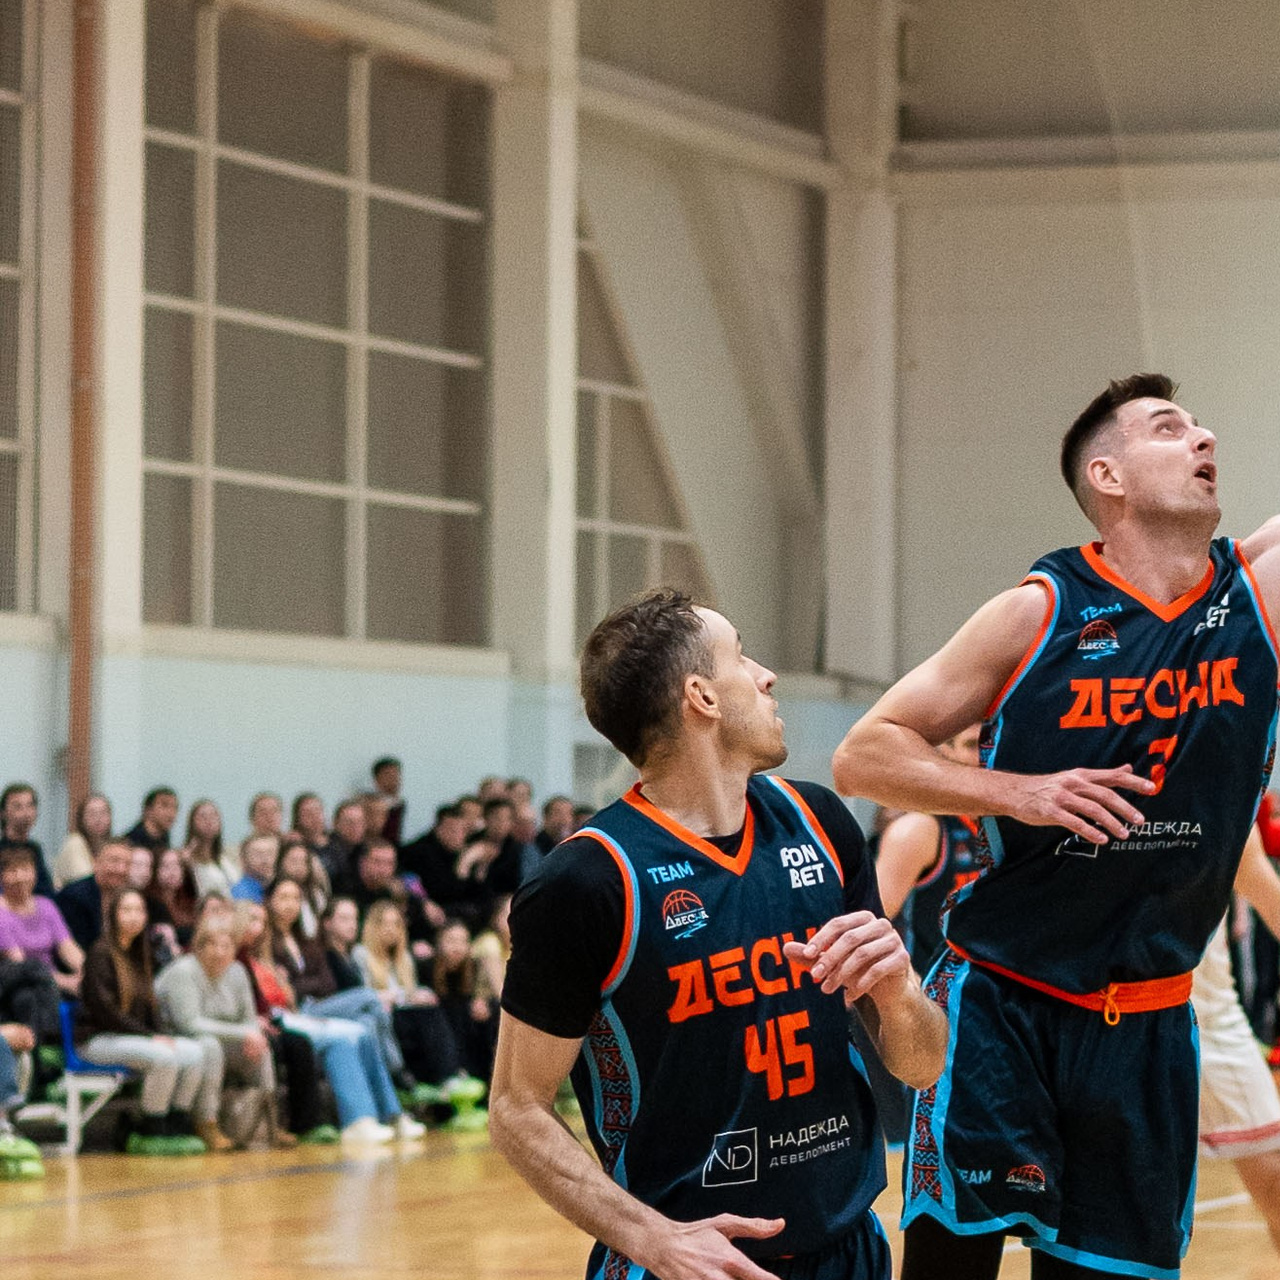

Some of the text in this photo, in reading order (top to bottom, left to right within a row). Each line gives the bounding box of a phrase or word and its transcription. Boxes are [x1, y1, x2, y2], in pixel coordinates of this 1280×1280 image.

[1080, 602, 1123, 621] TEAM
[1059, 657, 1245, 729] ДЕСНА
[780, 844, 819, 868] FON
[647, 860, 695, 885] TEAM
[789, 862, 825, 889] BET
[666, 926, 826, 1024] ДЕСН
[744, 1009, 816, 1101] 45
[769, 1115, 850, 1149] НАДЕЖДА
